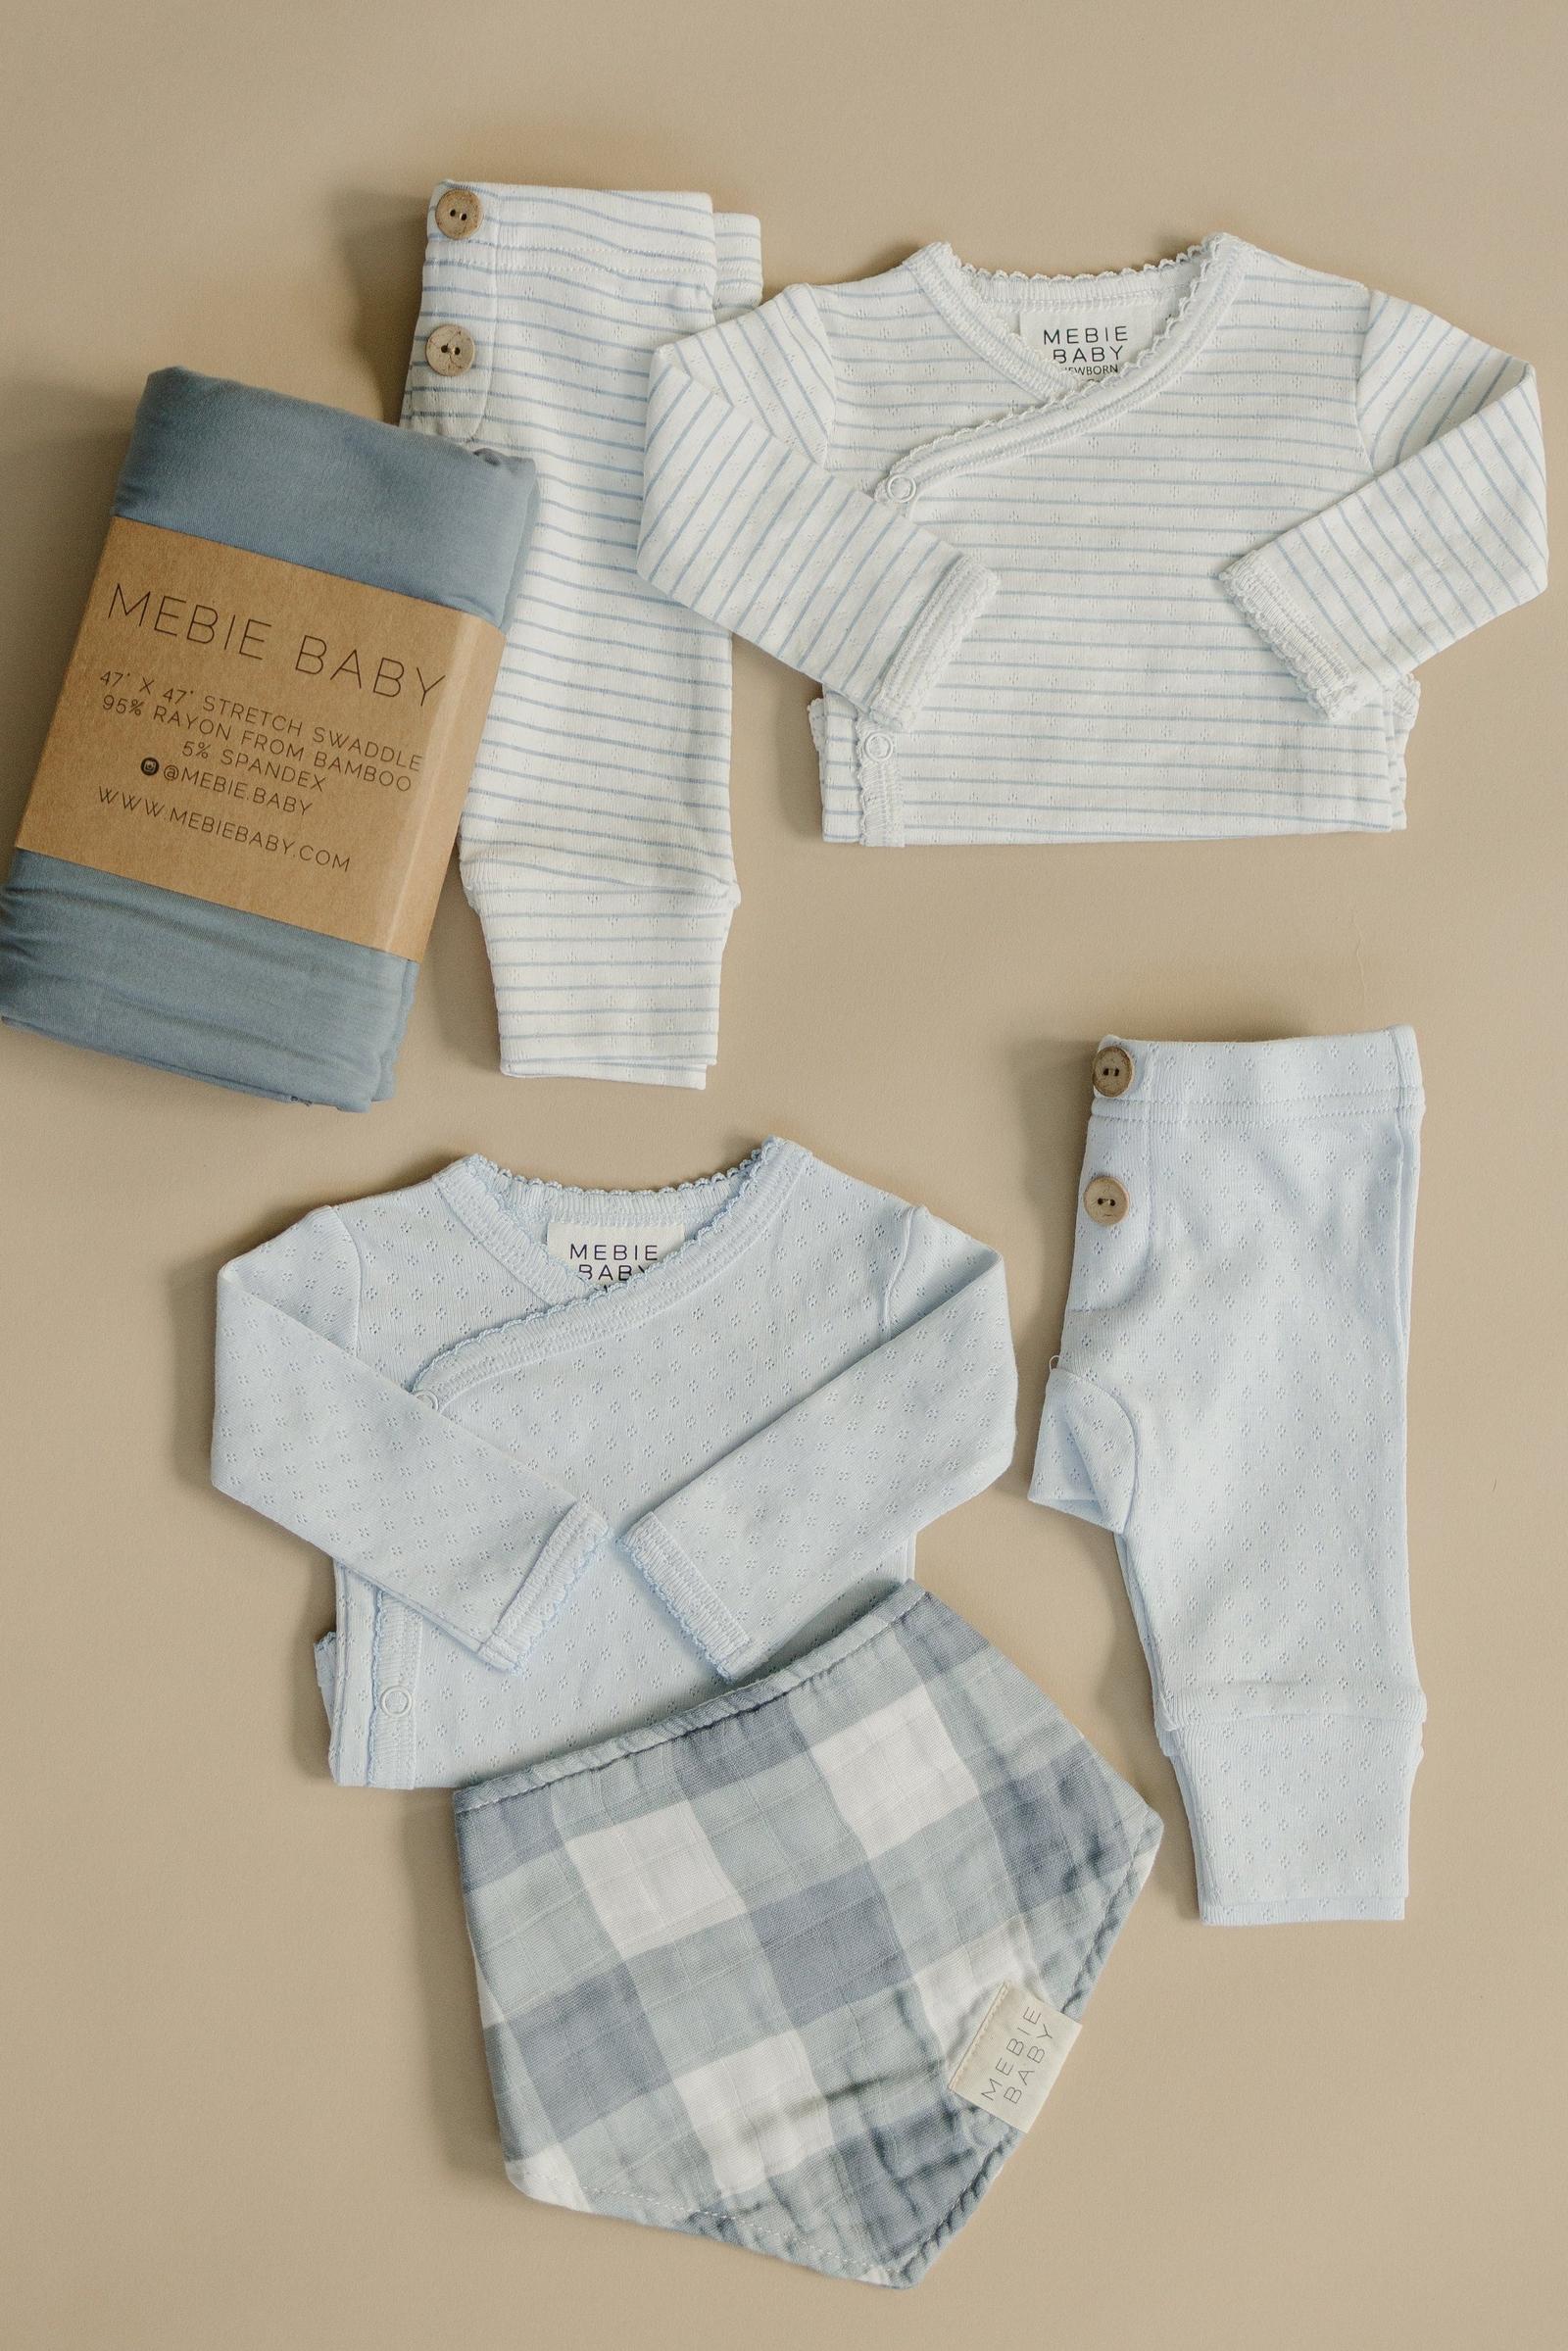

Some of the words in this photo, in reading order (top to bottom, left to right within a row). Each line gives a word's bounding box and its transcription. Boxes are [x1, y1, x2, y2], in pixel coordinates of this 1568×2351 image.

[1043, 325, 1128, 345] MEBIE
[1053, 345, 1124, 364] BABY
[1065, 364, 1118, 375] WBORN
[107, 583, 272, 661] MEBIE
[295, 634, 447, 707] BABY
[102, 694, 144, 716] 95%
[153, 705, 231, 741] RAYON
[241, 730, 305, 761] FROM
[314, 751, 412, 792] BAMBOO
[202, 695, 303, 737] STRETCH
[313, 727, 423, 772] SWADDLE
[163, 764, 313, 815] @MEBIE.BABY
[181, 740, 212, 759] 5%
[220, 749, 326, 792] SPANDEX
[98, 785, 351, 872] WWW.MEBIEBABY.COM
[569, 1243, 659, 1261] MEBIE
[981, 2007, 1042, 2101] MEBIE
[1003, 2024, 1053, 2104] BABY
